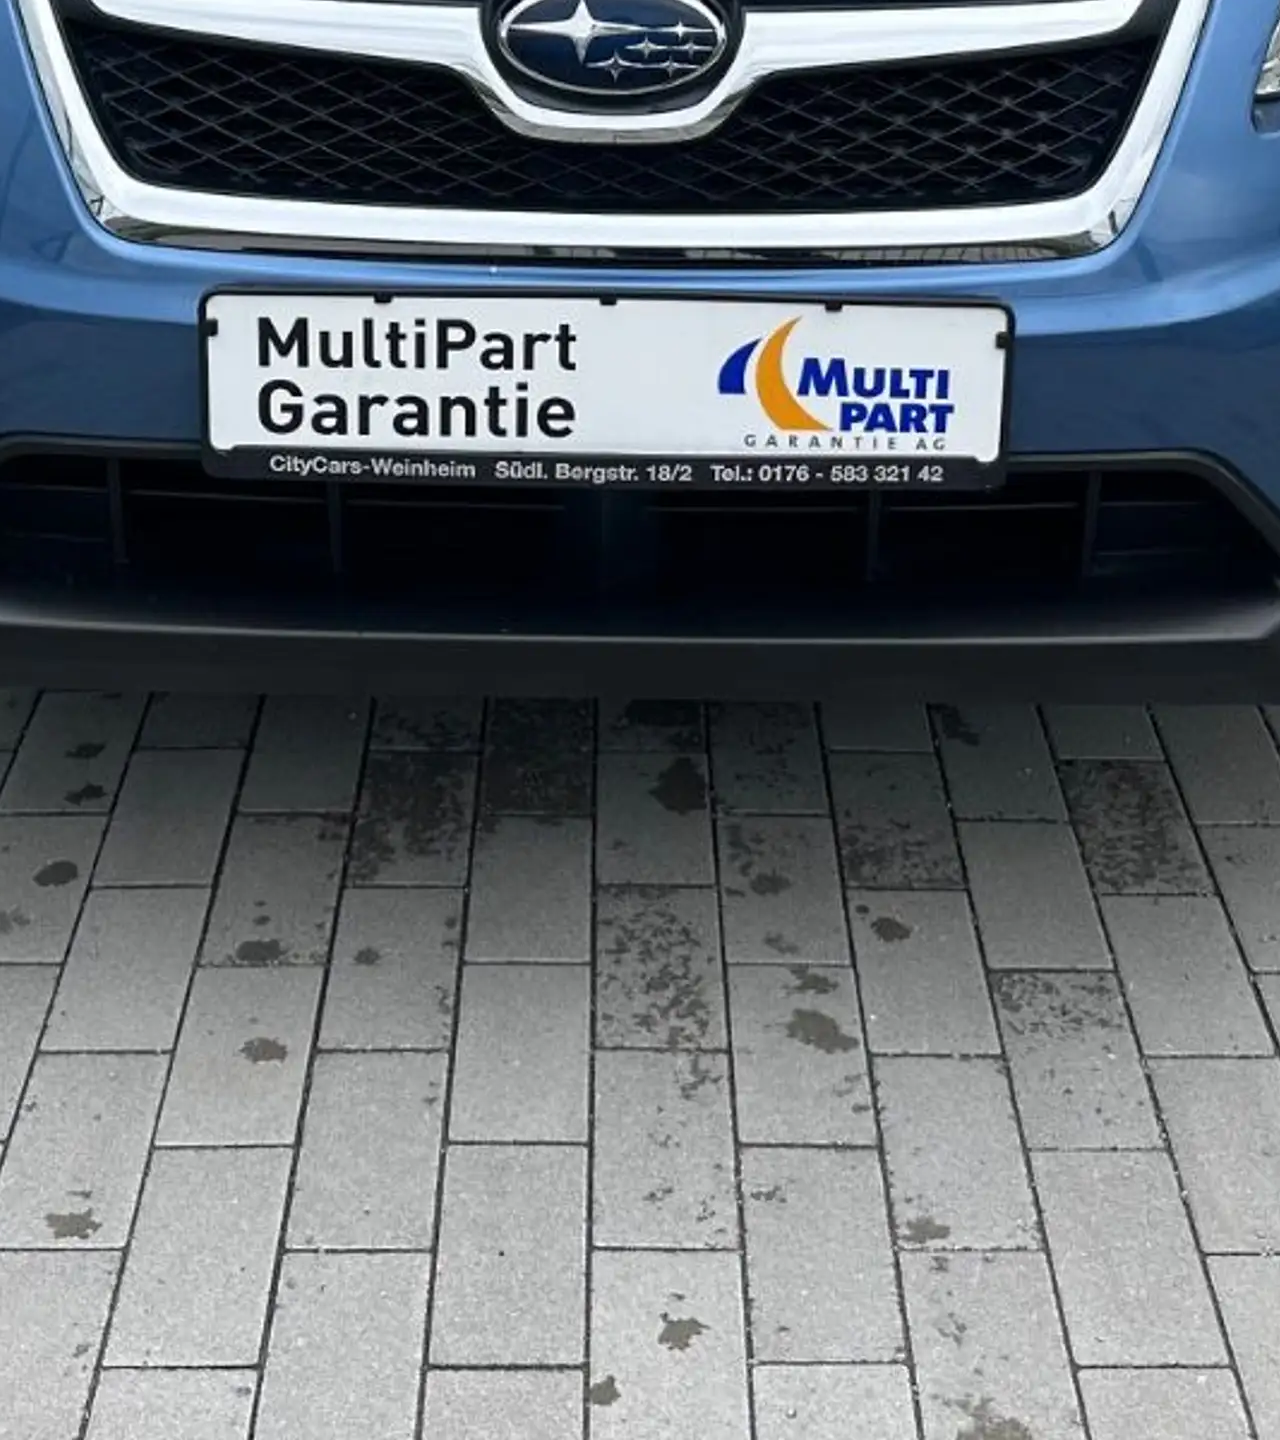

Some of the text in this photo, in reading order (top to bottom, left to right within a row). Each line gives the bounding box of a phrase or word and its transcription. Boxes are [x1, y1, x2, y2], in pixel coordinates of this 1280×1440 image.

[257, 316, 577, 371] MultiPart
[797, 357, 950, 399] MULTI
[257, 378, 576, 438] Garantie
[839, 401, 954, 433] PART
[743, 434, 946, 451] GARANTIE AG
[269, 455, 476, 479] CityCars-Weinheim
[494, 461, 549, 480] Südl.
[555, 462, 640, 484] Bergstr.
[646, 464, 692, 482] 18/2
[709, 465, 753, 482] Tel.:
[758, 465, 810, 482] 0176
[830, 465, 869, 482] 583
[873, 465, 910, 482] 321
[916, 465, 944, 482] 42
